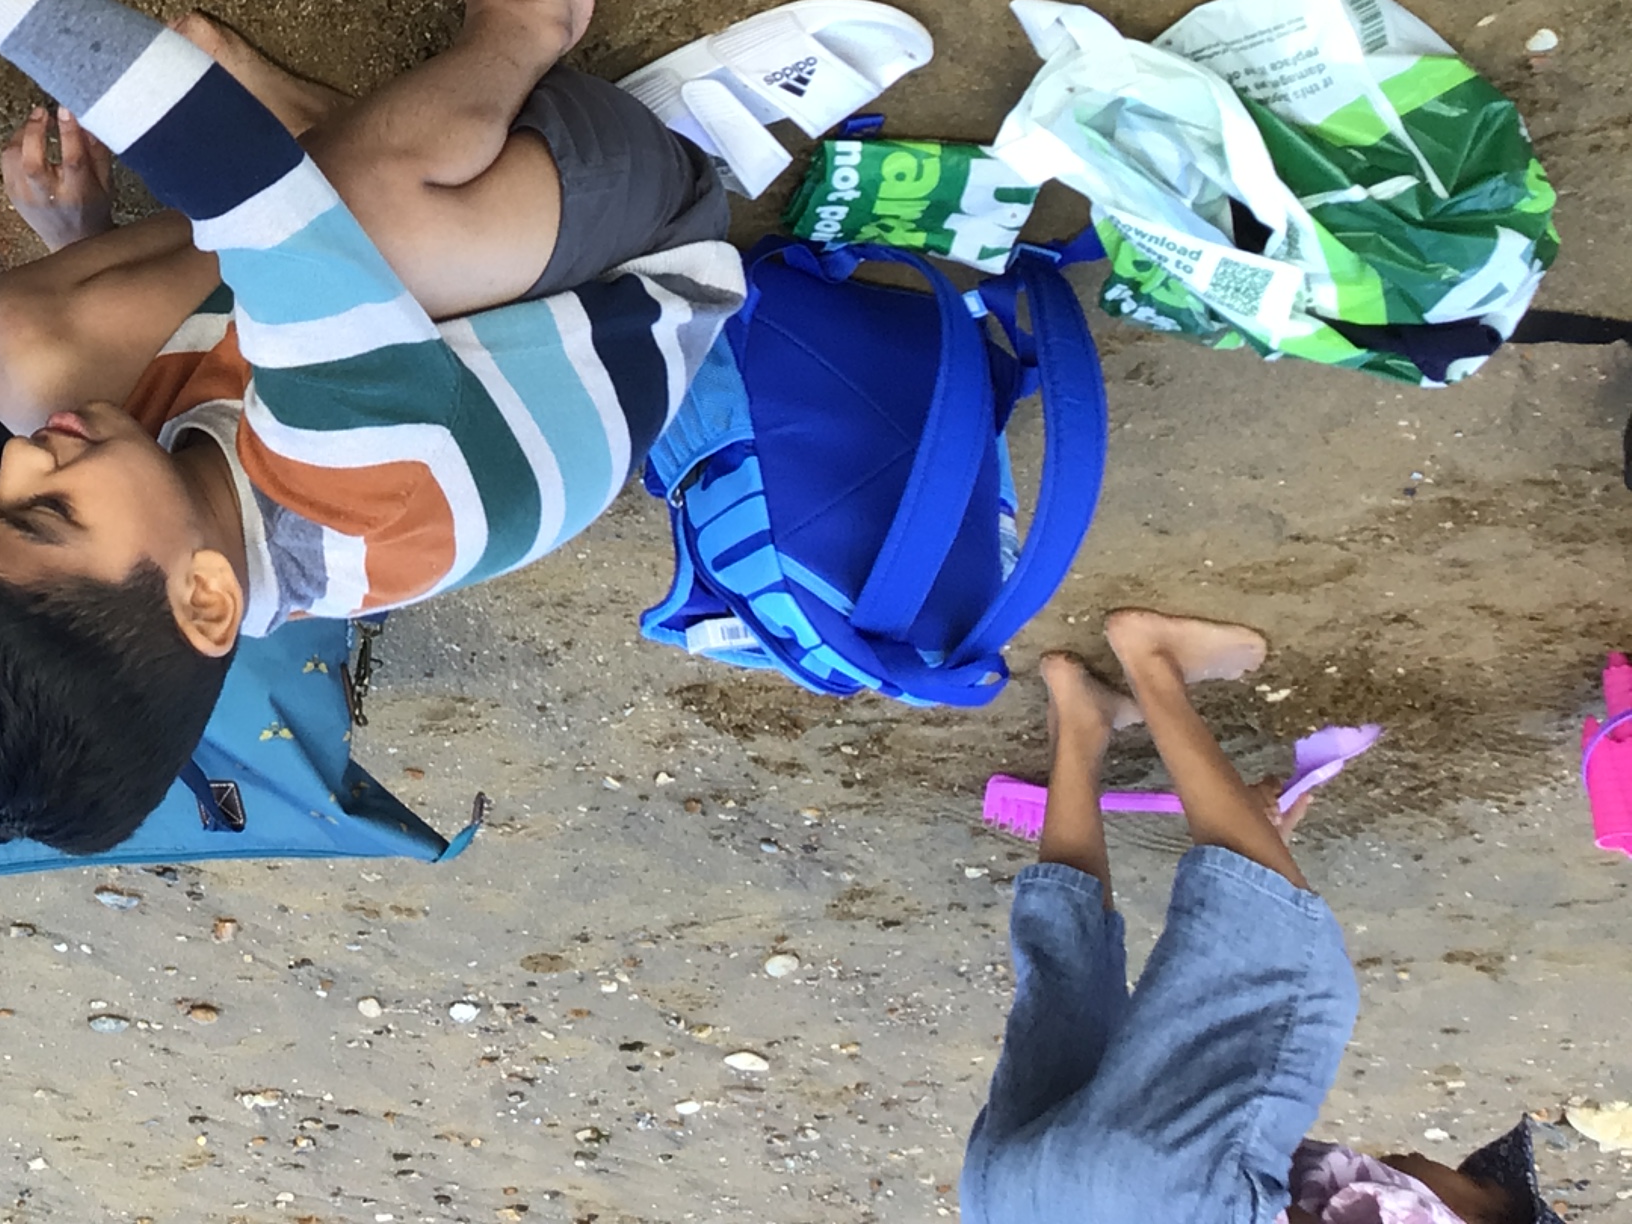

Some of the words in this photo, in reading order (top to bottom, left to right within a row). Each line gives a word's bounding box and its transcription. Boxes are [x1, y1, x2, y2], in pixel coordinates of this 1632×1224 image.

[763, 56, 818, 85] adidas
[826, 141, 863, 201] not
[1174, 259, 1194, 275] to
